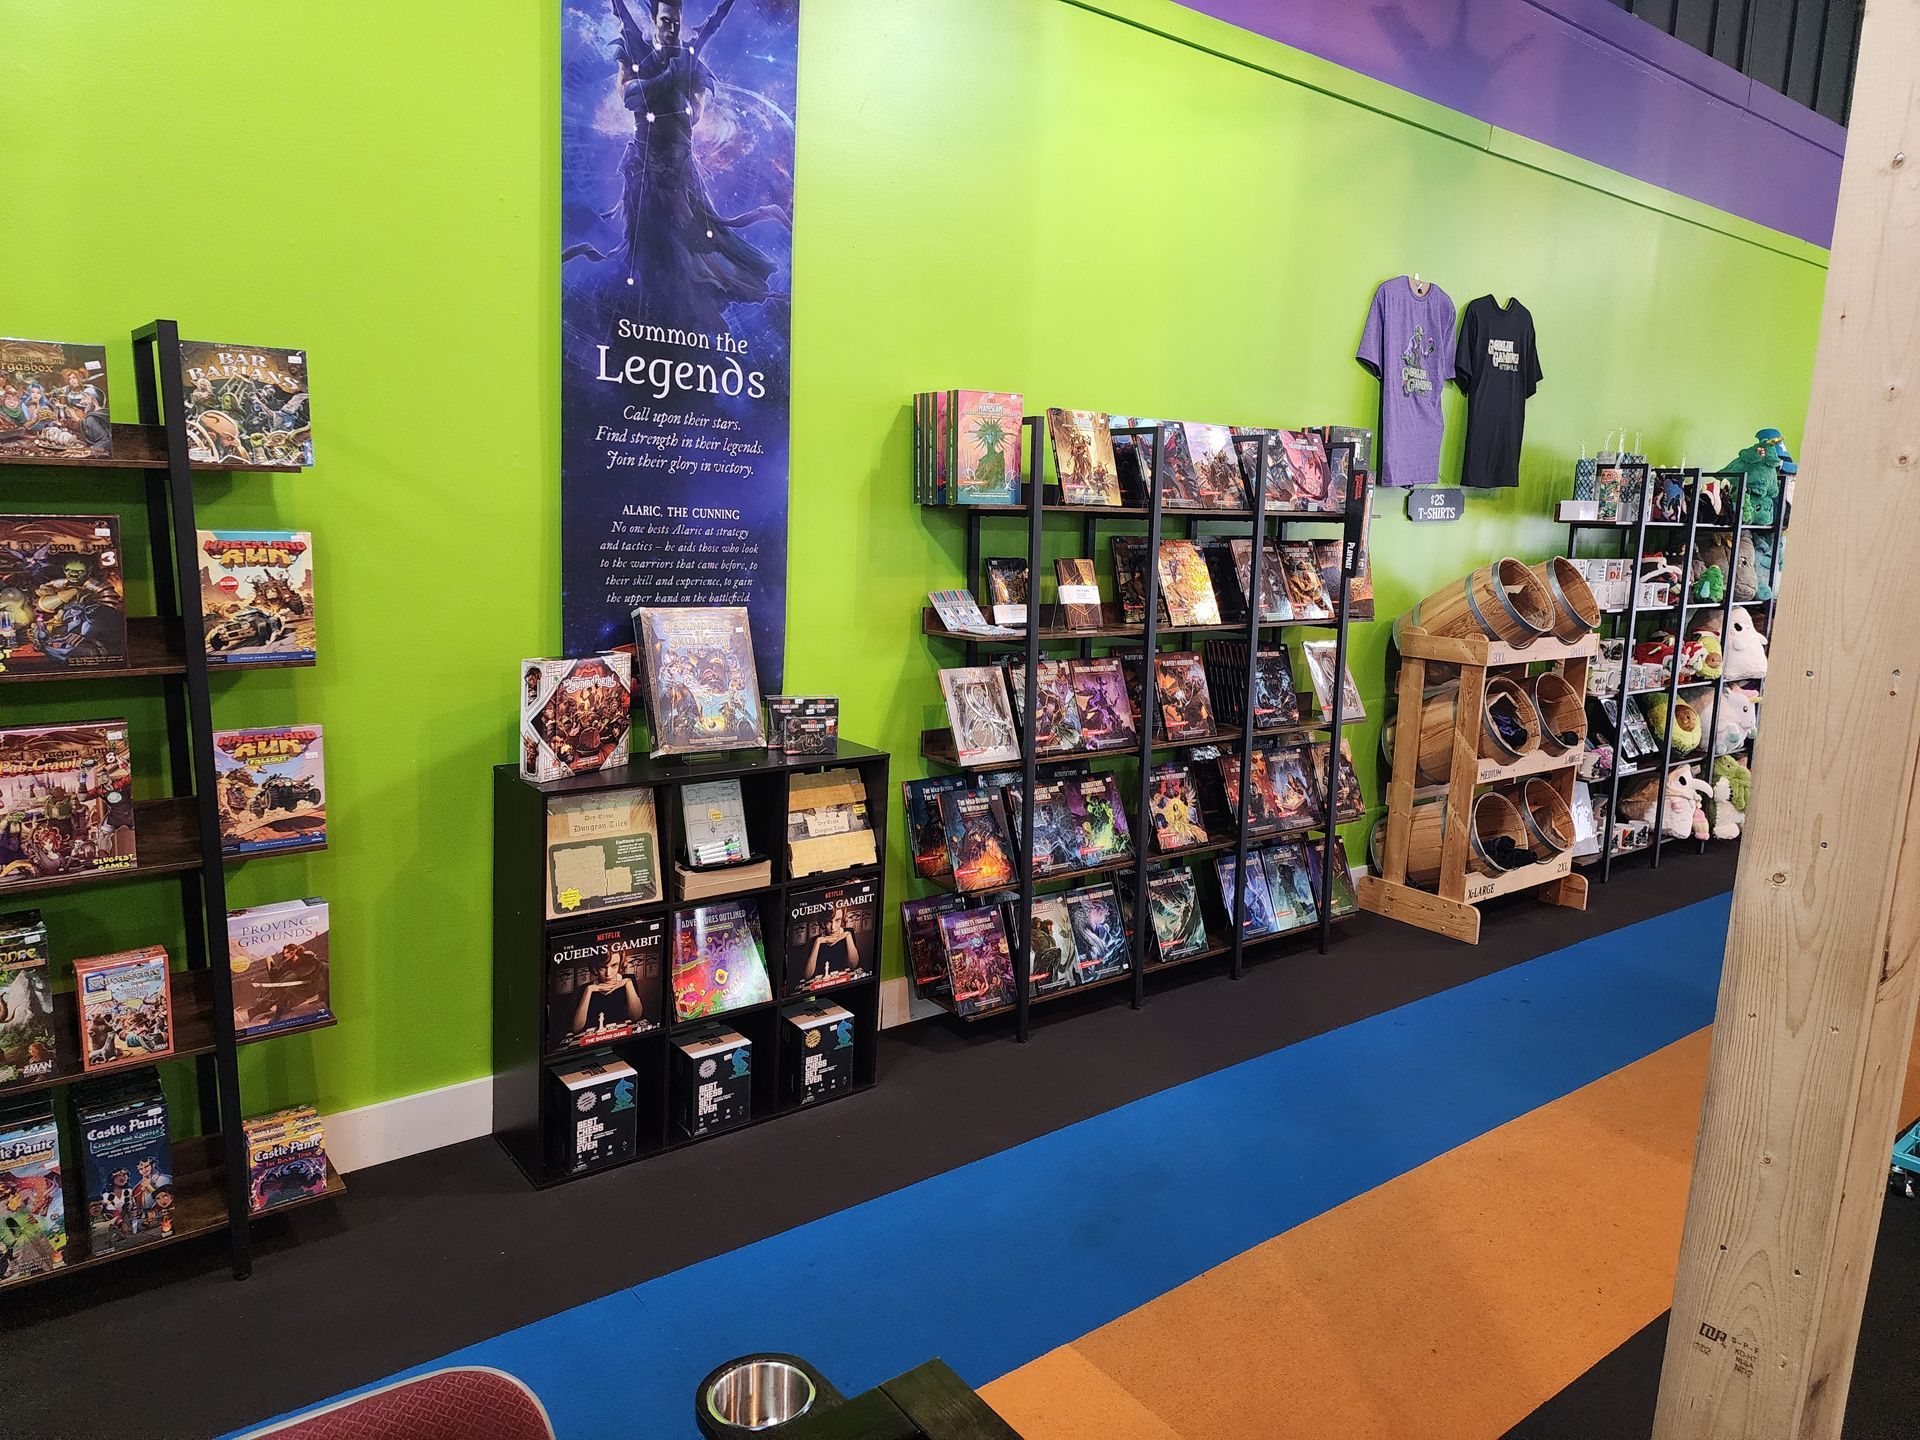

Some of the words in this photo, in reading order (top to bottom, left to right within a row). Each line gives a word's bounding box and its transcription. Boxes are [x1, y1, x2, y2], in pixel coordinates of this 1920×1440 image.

[618, 318, 709, 349] Summon
[716, 333, 748, 354] the
[216, 352, 266, 368] BAR
[0, 362, 53, 373] rgasbox
[596, 345, 765, 399] Legends
[186, 365, 300, 390] BARIANS
[623, 405, 650, 422] Call
[653, 409, 682, 427] upon
[683, 413, 710, 428] their
[712, 416, 742, 431] stars.
[595, 426, 627, 443] Find
[629, 430, 679, 450] strength
[681, 435, 693, 449] in
[695, 436, 721, 451] their
[723, 438, 765, 457] legends.
[607, 449, 636, 470] Join
[638, 453, 667, 469] their
[669, 458, 698, 475] glory
[700, 461, 712, 473] in
[713, 462, 755, 478] victory.
[1430, 494, 1445, 507] $25
[622, 504, 663, 518] ALARIC,
[667, 506, 688, 518] THE
[692, 508, 740, 520] CUNNING
[1418, 507, 1456, 520] T-SHIRTS
[611, 521, 627, 534] No
[629, 525, 645, 535] one
[647, 523, 669, 535] bests
[671, 524, 703, 536] Alaric
[705, 527, 713, 537] at
[716, 527, 750, 540] strategy
[203, 540, 307, 552] WRECKLAND
[600, 540, 619, 551] and
[621, 540, 653, 551] tactics
[665, 542, 676, 552] he
[677, 542, 696, 553] aids
[698, 542, 720, 554] those
[722, 543, 740, 554] who
[741, 542, 759, 554] look
[102, 551, 116, 566] 3
[220, 548, 292, 568] RUN
[600, 558, 609, 568] to
[611, 558, 627, 569] the
[630, 558, 674, 570] warriors
[676, 558, 695, 570] that
[697, 560, 718, 570] came
[720, 559, 748, 572] before,
[749, 560, 758, 570] to
[605, 575, 629, 587] their
[632, 575, 653, 587] skill
[655, 576, 673, 587] and
[675, 577, 722, 589] experience,
[724, 577, 732, 587] to
[734, 578, 753, 590] gain
[606, 592, 622, 603] the
[624, 594, 652, 606] upper
[654, 592, 679, 603] hand
[680, 595, 691, 603] on
[692, 592, 707, 604] the
[708, 592, 752, 604] battlefield.
[218, 730, 317, 746] WRECKLAND
[232, 739, 303, 759] RUN
[105, 752, 116, 763] 8
[1480, 767, 1502, 780] MEDIUM
[573, 823, 607, 833] Dungeon
[608, 820, 628, 828] Tiles
[98, 862, 130, 871] GAMES
[1468, 883, 1496, 900] X-LARGE
[791, 901, 834, 919] QUEEN'S
[835, 893, 875, 909] GAMBIT
[681, 913, 719, 929] ADVEURES
[719, 909, 747, 921] OUTLINED
[238, 926, 314, 948] GROUNDS
[596, 931, 621, 941] NETFLIX
[553, 944, 608, 965] QUEEN'S
[611, 934, 661, 952] GAMBIT
[595, 1034, 614, 1042] BOARD
[613, 1030, 629, 1039] GAME
[805, 1053, 823, 1064] BEST
[805, 1059, 827, 1070] CHESS
[805, 1069, 818, 1079] SET
[805, 1074, 823, 1086] EVER
[699, 1081, 718, 1093] BEST
[699, 1087, 723, 1100] CHESS
[698, 1098, 713, 1108] SET
[698, 1103, 718, 1116] EVER
[86, 1124, 127, 1142] Castle
[129, 1115, 164, 1133] Panic
[577, 1116, 599, 1130] BEST
[577, 1123, 604, 1138] CHESS
[577, 1134, 593, 1146] SET
[577, 1140, 599, 1154] EVER
[13, 1138, 56, 1158] Panic
[254, 1144, 288, 1162] Castle
